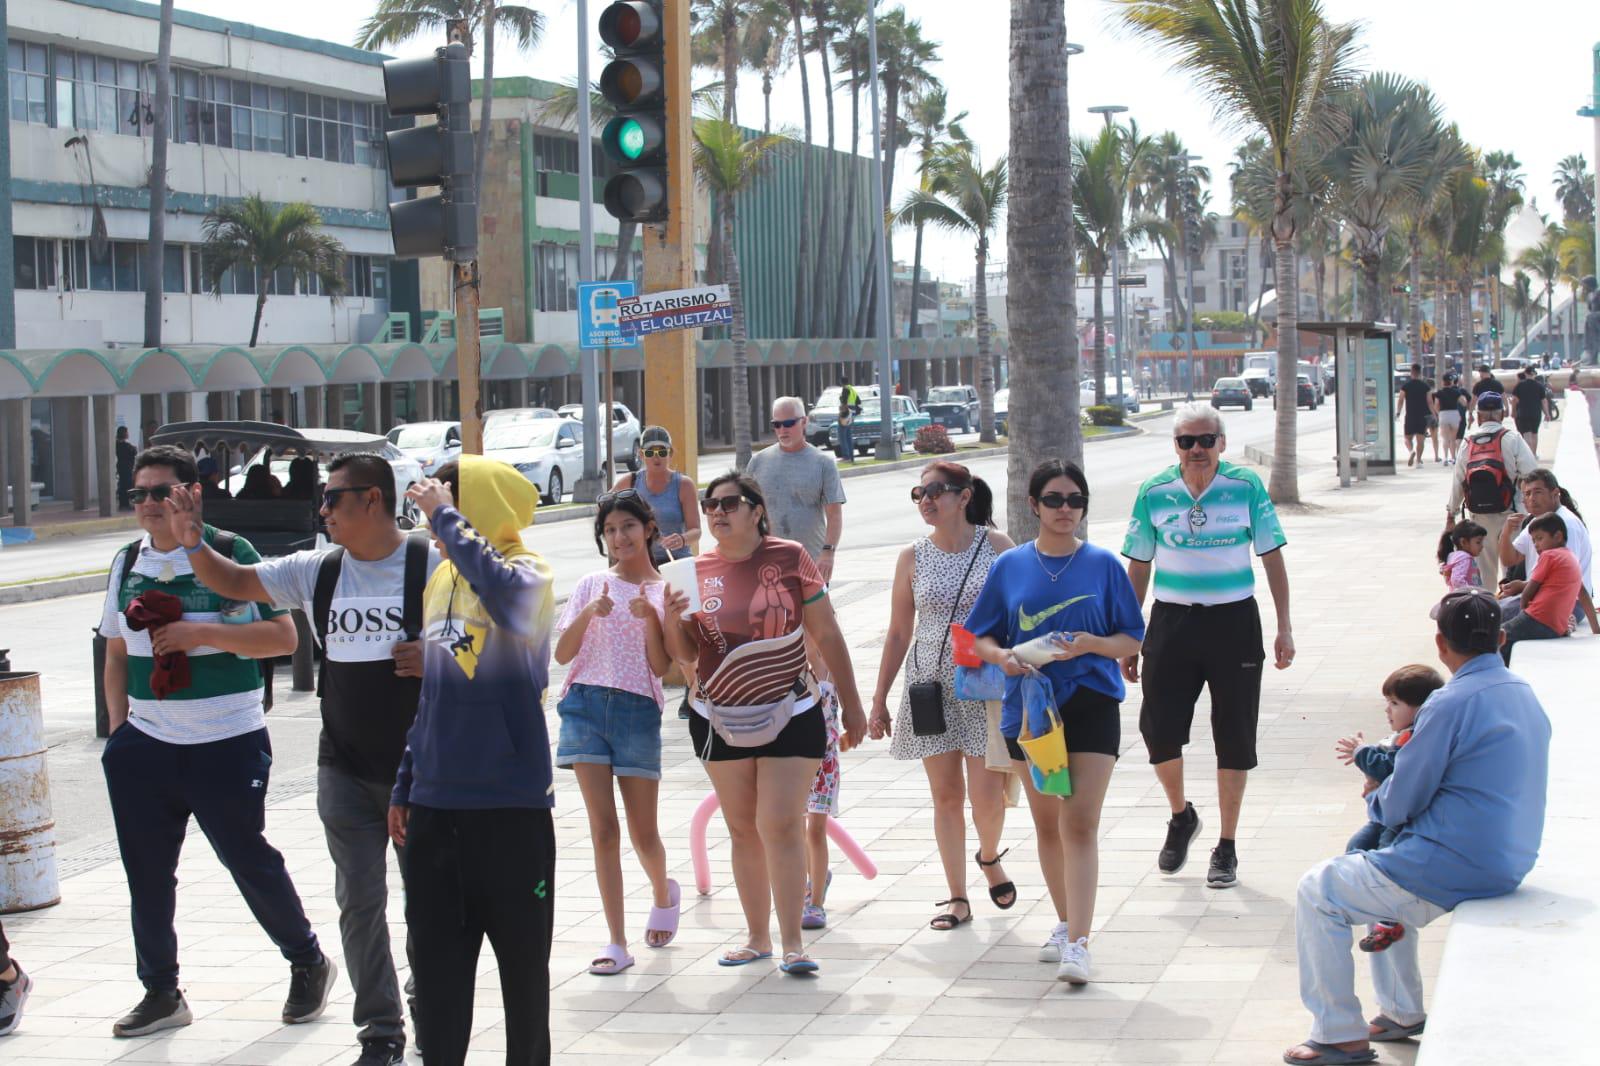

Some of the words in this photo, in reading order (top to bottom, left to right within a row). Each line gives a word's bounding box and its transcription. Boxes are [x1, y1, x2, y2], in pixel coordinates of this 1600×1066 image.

[620, 293, 717, 316] ROTARISMO
[640, 319, 660, 331] EL
[662, 308, 733, 328] QUETZAL
[1186, 537, 1237, 546] Soriana
[327, 606, 403, 634] BOSS
[365, 634, 403, 642] BOSS
